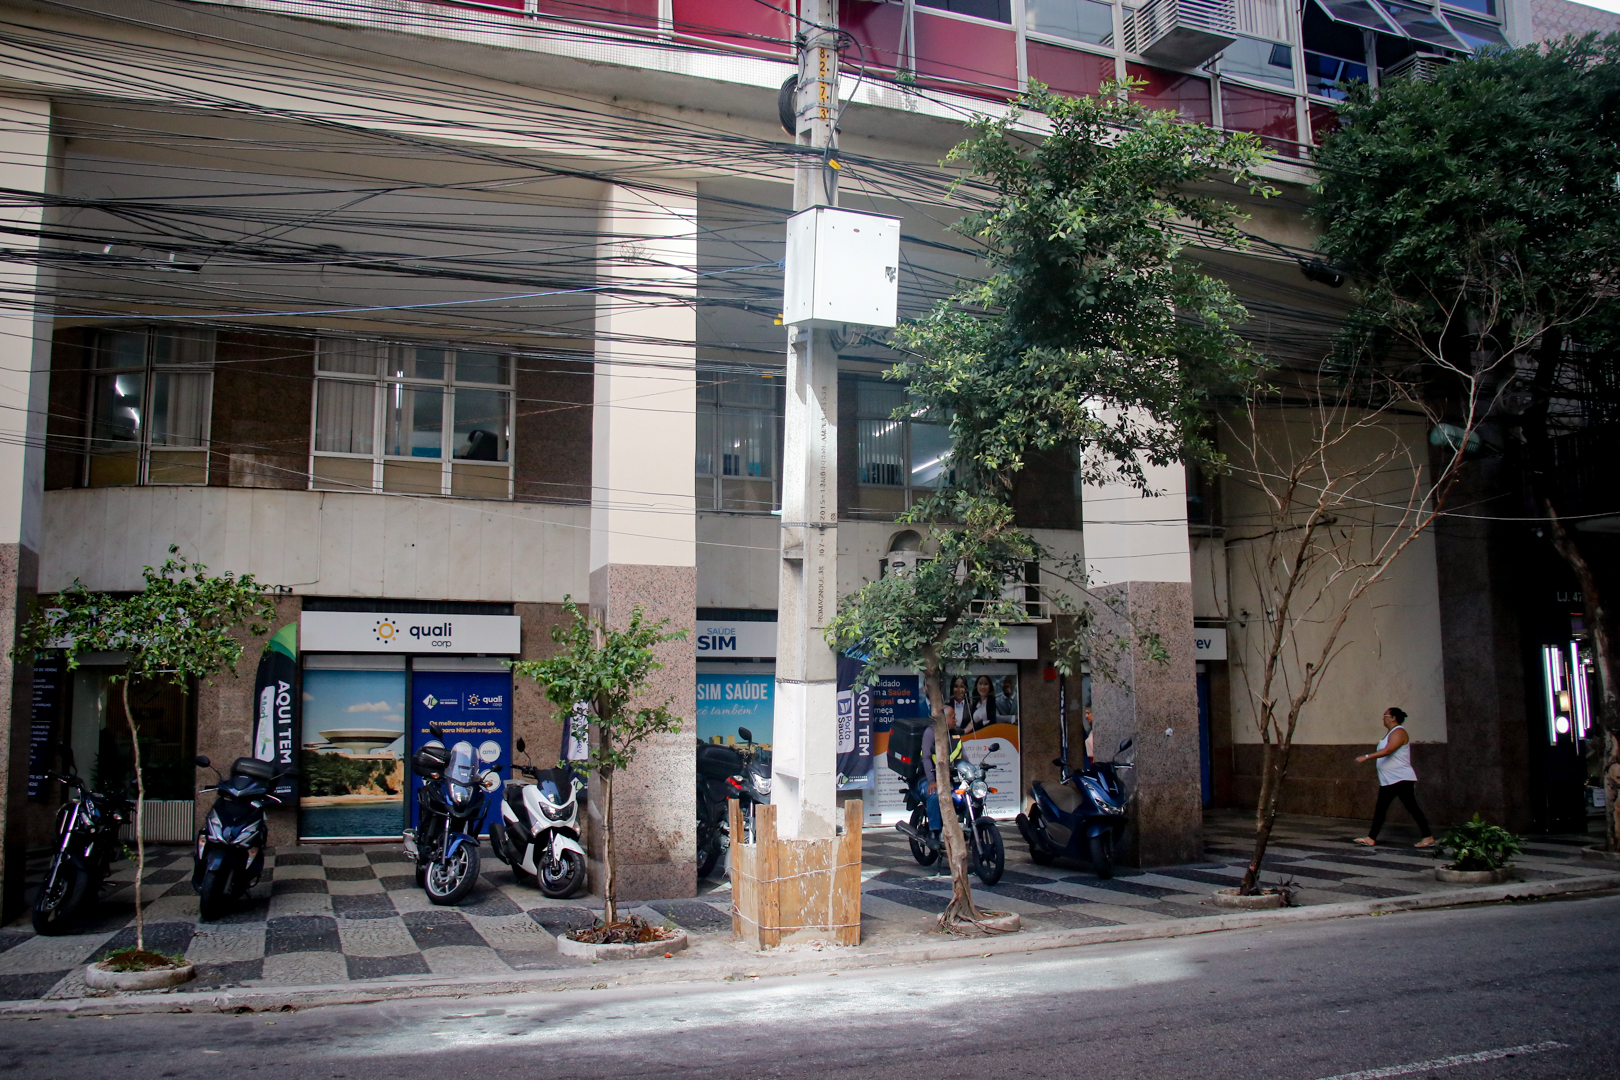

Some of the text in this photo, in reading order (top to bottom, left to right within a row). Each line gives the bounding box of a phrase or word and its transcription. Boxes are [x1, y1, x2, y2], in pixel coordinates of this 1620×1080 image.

[409, 623, 452, 639] quali
[707, 626, 736, 635] SAÚDE
[431, 639, 452, 649] corp
[697, 635, 736, 650] SIM
[1194, 638, 1212, 650] ev
[876, 679, 901, 687] uidado
[725, 680, 768, 700] SAÚDE
[887, 688, 911, 696] Saúde
[482, 695, 503, 704] quali
[710, 703, 759, 716] também!
[276, 680, 292, 764] AQUI TEM
[857, 685, 870, 756] AQUI TEM
[878, 715, 895, 724] aqui
